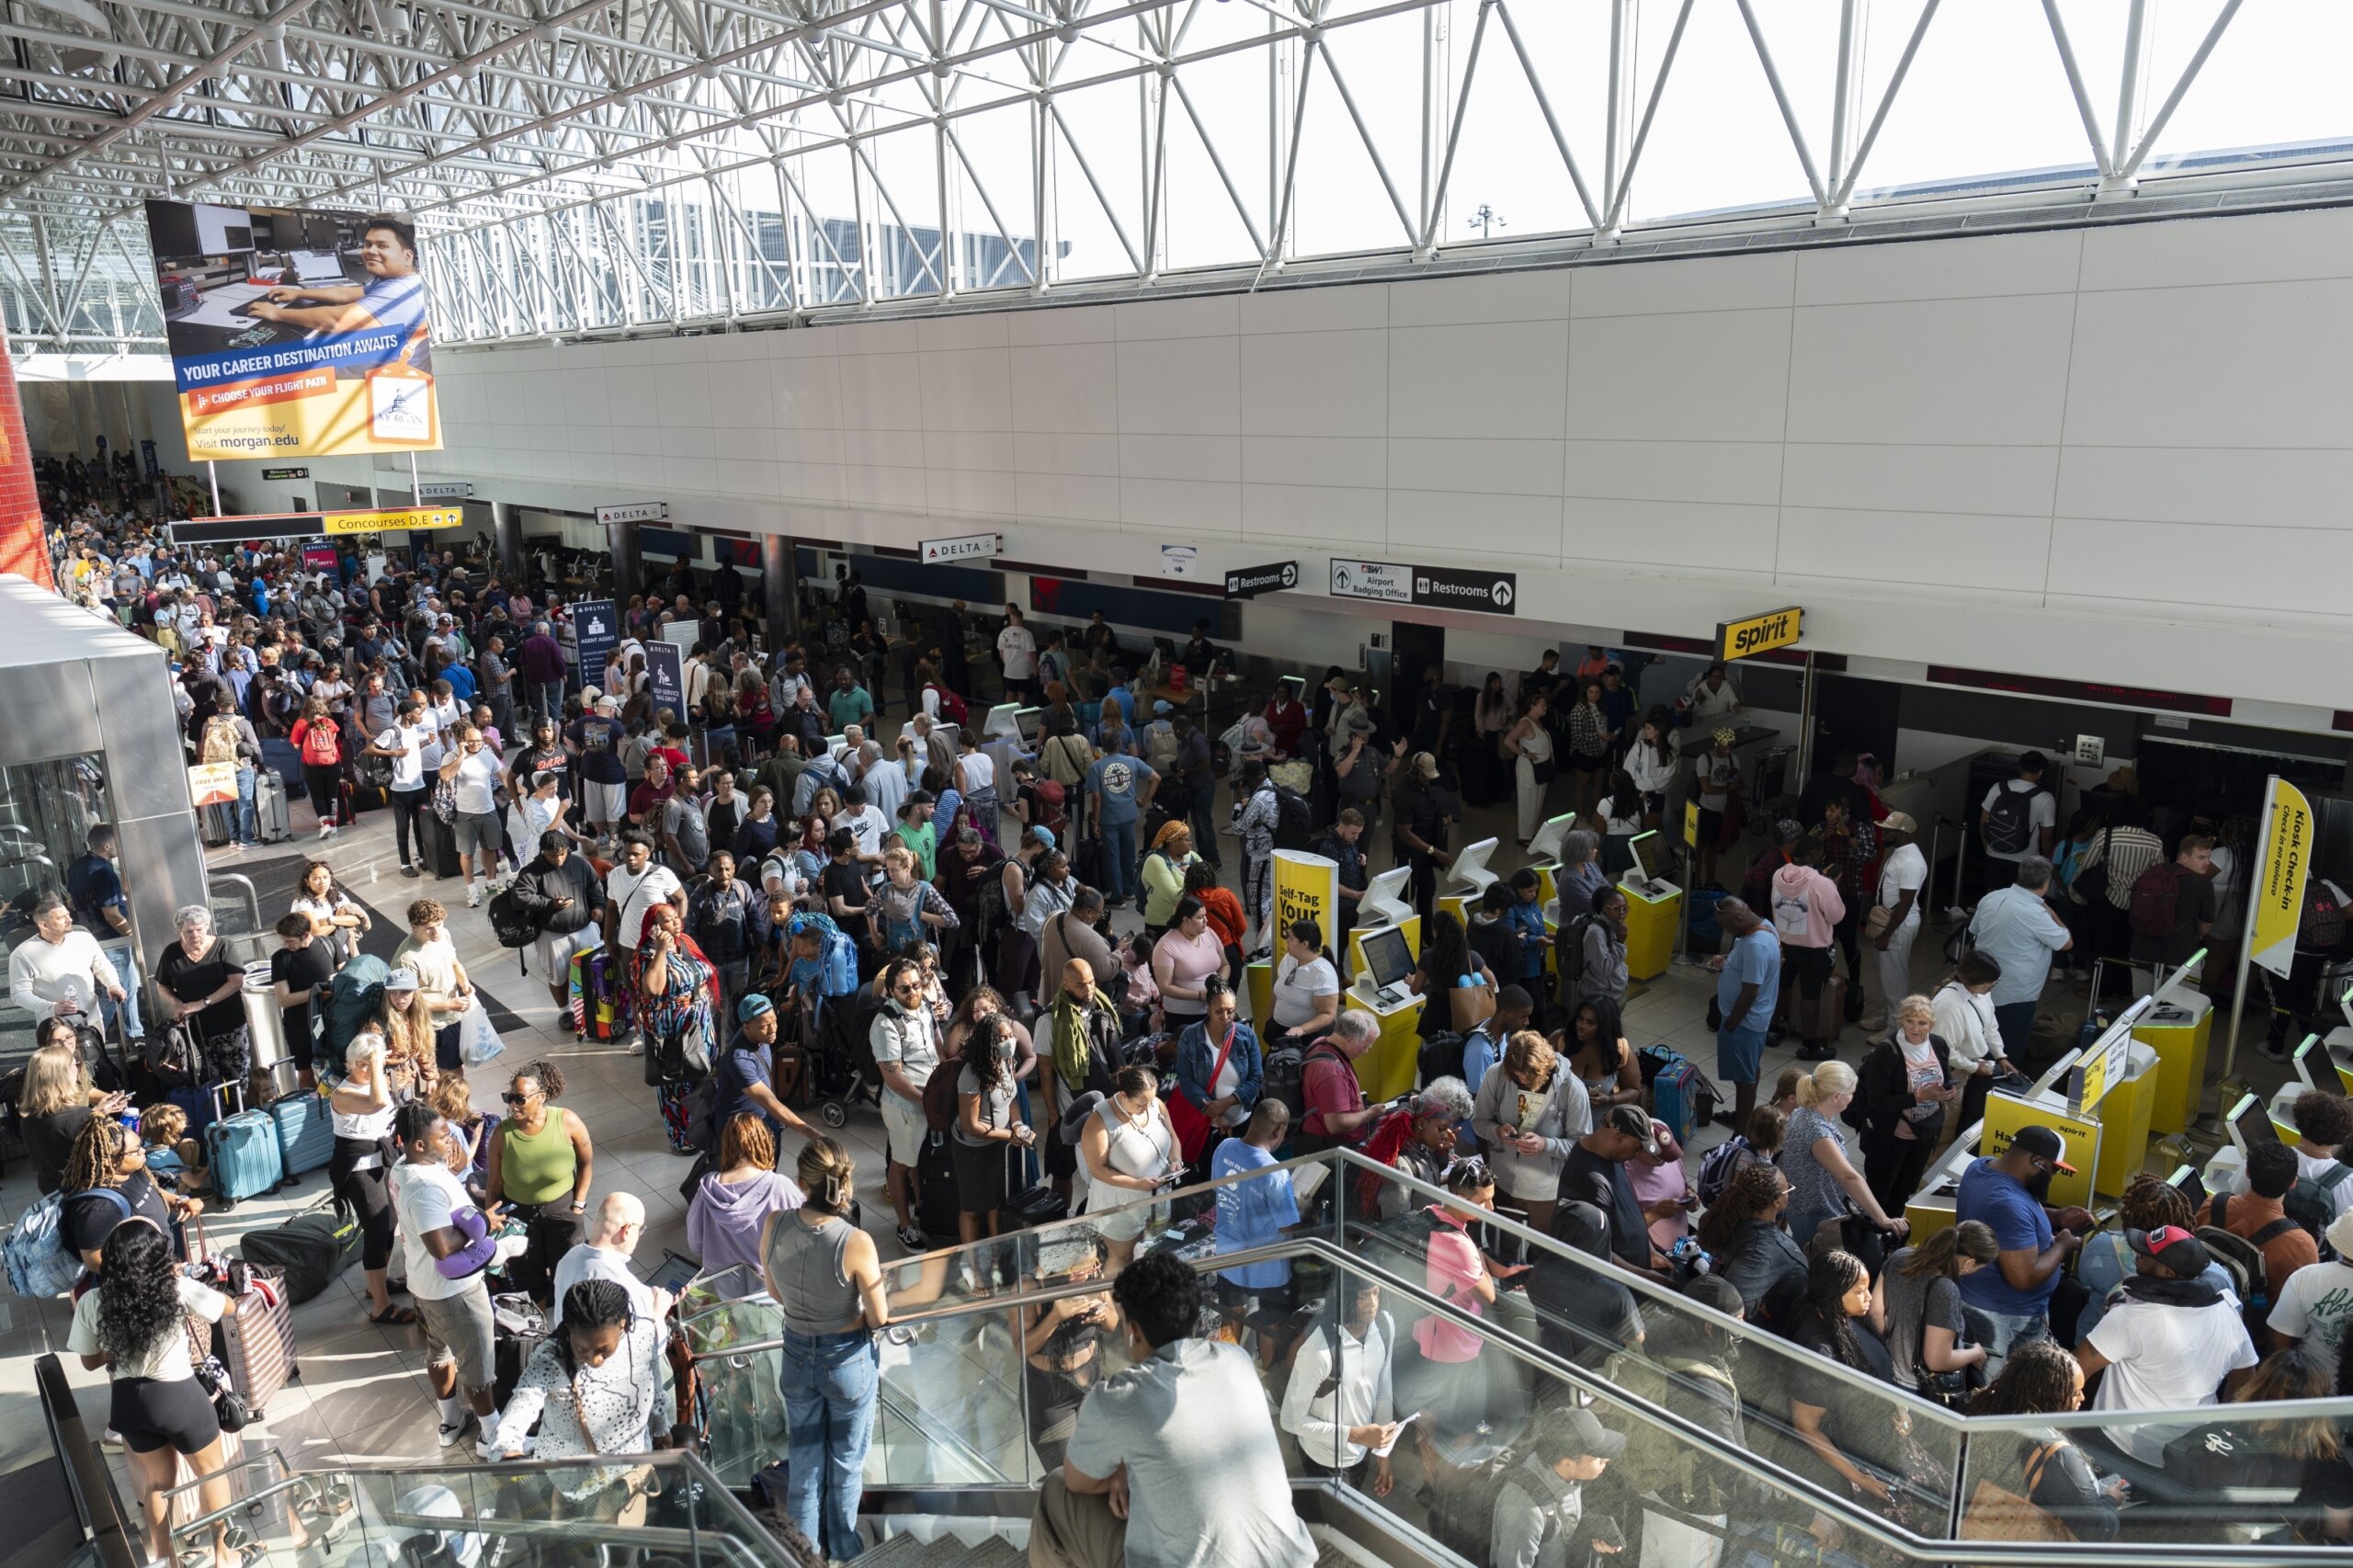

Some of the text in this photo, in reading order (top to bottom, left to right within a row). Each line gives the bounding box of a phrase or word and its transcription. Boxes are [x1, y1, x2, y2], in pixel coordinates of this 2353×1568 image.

[183, 334, 398, 381] YOUR CAREER DESTINATION AWAITS
[211, 376, 327, 404] CHOOSE YOUR FLIGHT PATH
[193, 425, 286, 436] Start your journey today!
[195, 434, 300, 450] Visit morgan.edu
[338, 515, 428, 529] Concourses D,E
[614, 510, 648, 519] DELTA
[941, 543, 981, 556] DELTA
[1368, 565, 1382, 574] BWI
[1241, 574, 1280, 588] Restrooms
[1367, 576, 1394, 587] Airport
[1353, 585, 1408, 598] Badging Office
[1433, 581, 1489, 597] Restrooms
[1735, 615, 1789, 652] spirit
[2270, 805, 2290, 896] Check in en quiosco
[2281, 810, 2304, 911] Kiosk Check-in
[1279, 884, 1319, 907] Self-Tag
[1279, 895, 1320, 921] Your
[2058, 1125, 2087, 1138] spirit
